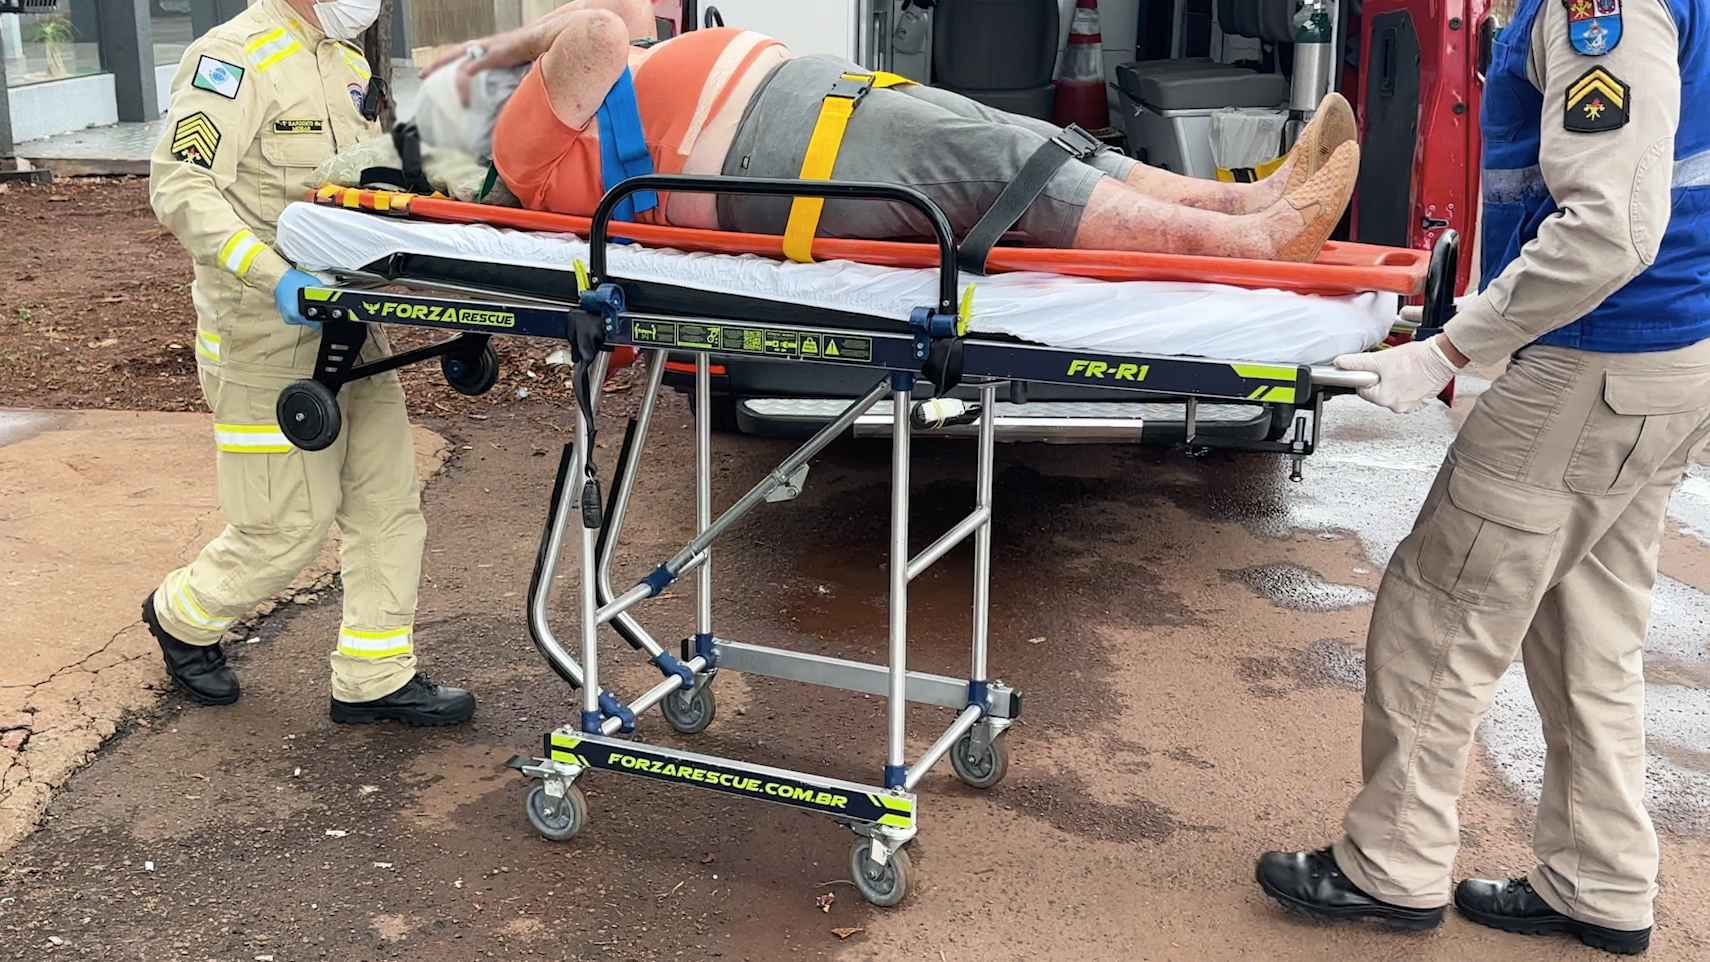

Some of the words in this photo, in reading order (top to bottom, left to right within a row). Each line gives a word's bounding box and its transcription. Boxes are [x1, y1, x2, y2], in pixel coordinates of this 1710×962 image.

[381, 302, 457, 323] FORZA
[461, 312, 513, 325] RESCUE
[1067, 359, 1150, 381] FR-R1
[607, 752, 848, 809] FORZARESCUE.COM.BR
